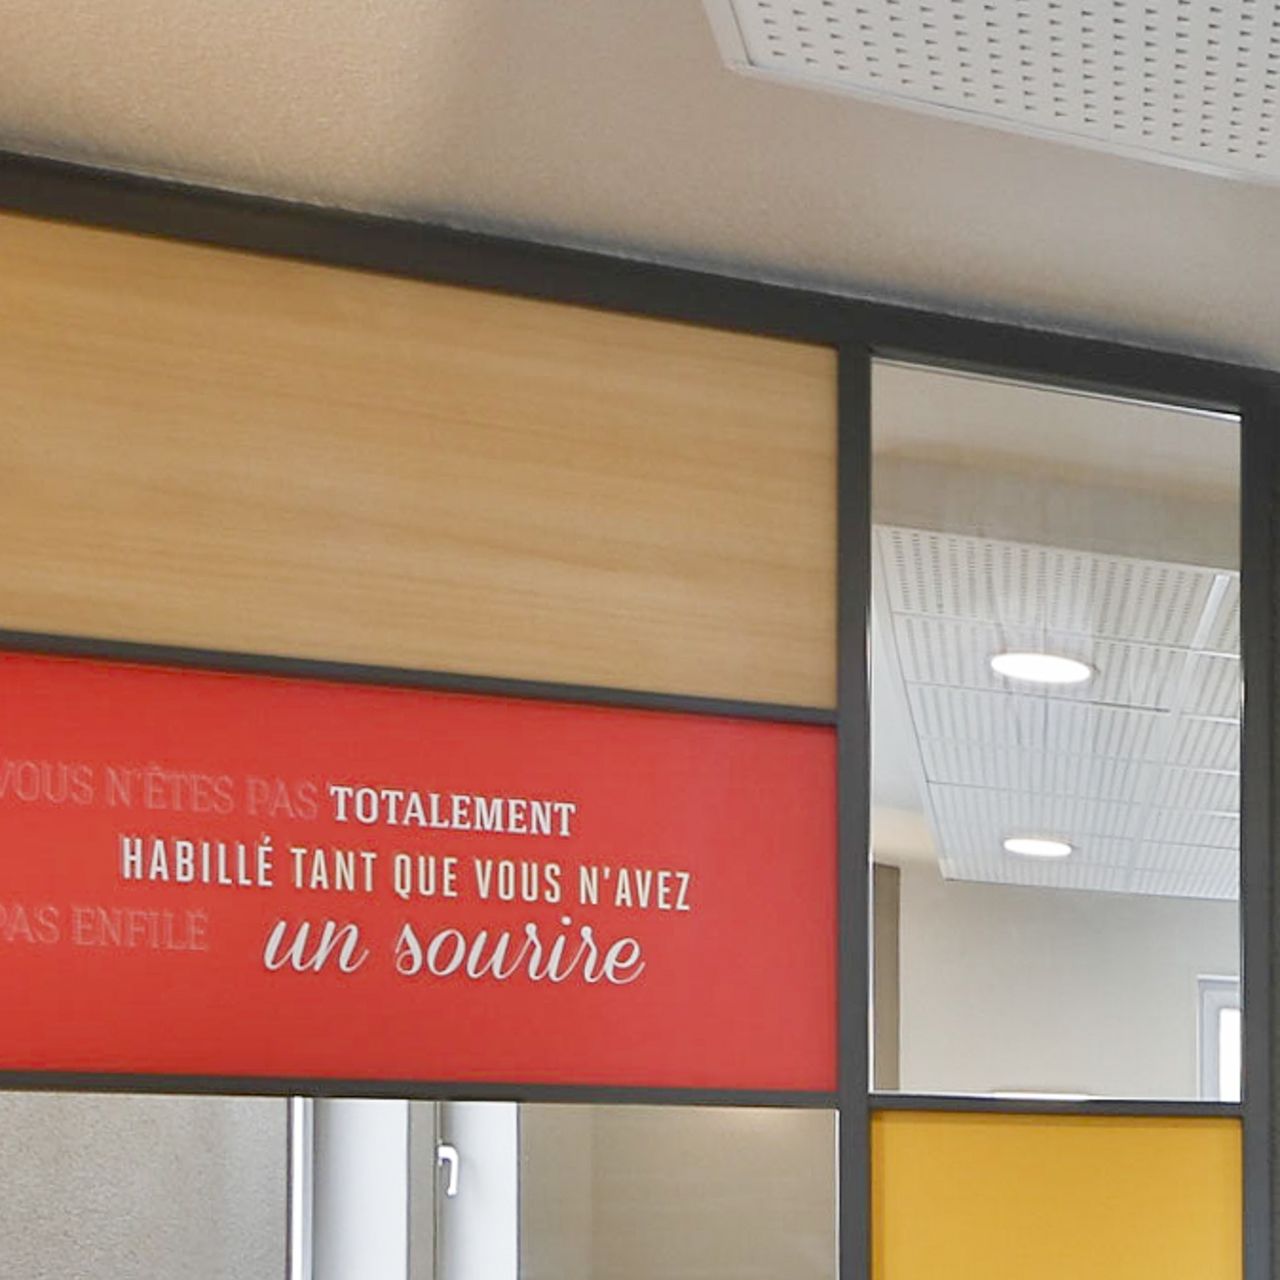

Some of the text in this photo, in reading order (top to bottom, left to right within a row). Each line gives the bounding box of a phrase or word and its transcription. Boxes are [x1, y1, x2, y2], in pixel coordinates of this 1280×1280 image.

[244, 775, 319, 821] PAS
[329, 785, 577, 837] TOTALEMENT
[121, 834, 691, 911] HABILLÉ TANT QUE VOUS N'AVEZ
[262, 919, 369, 973] un
[394, 915, 646, 985] sourire
